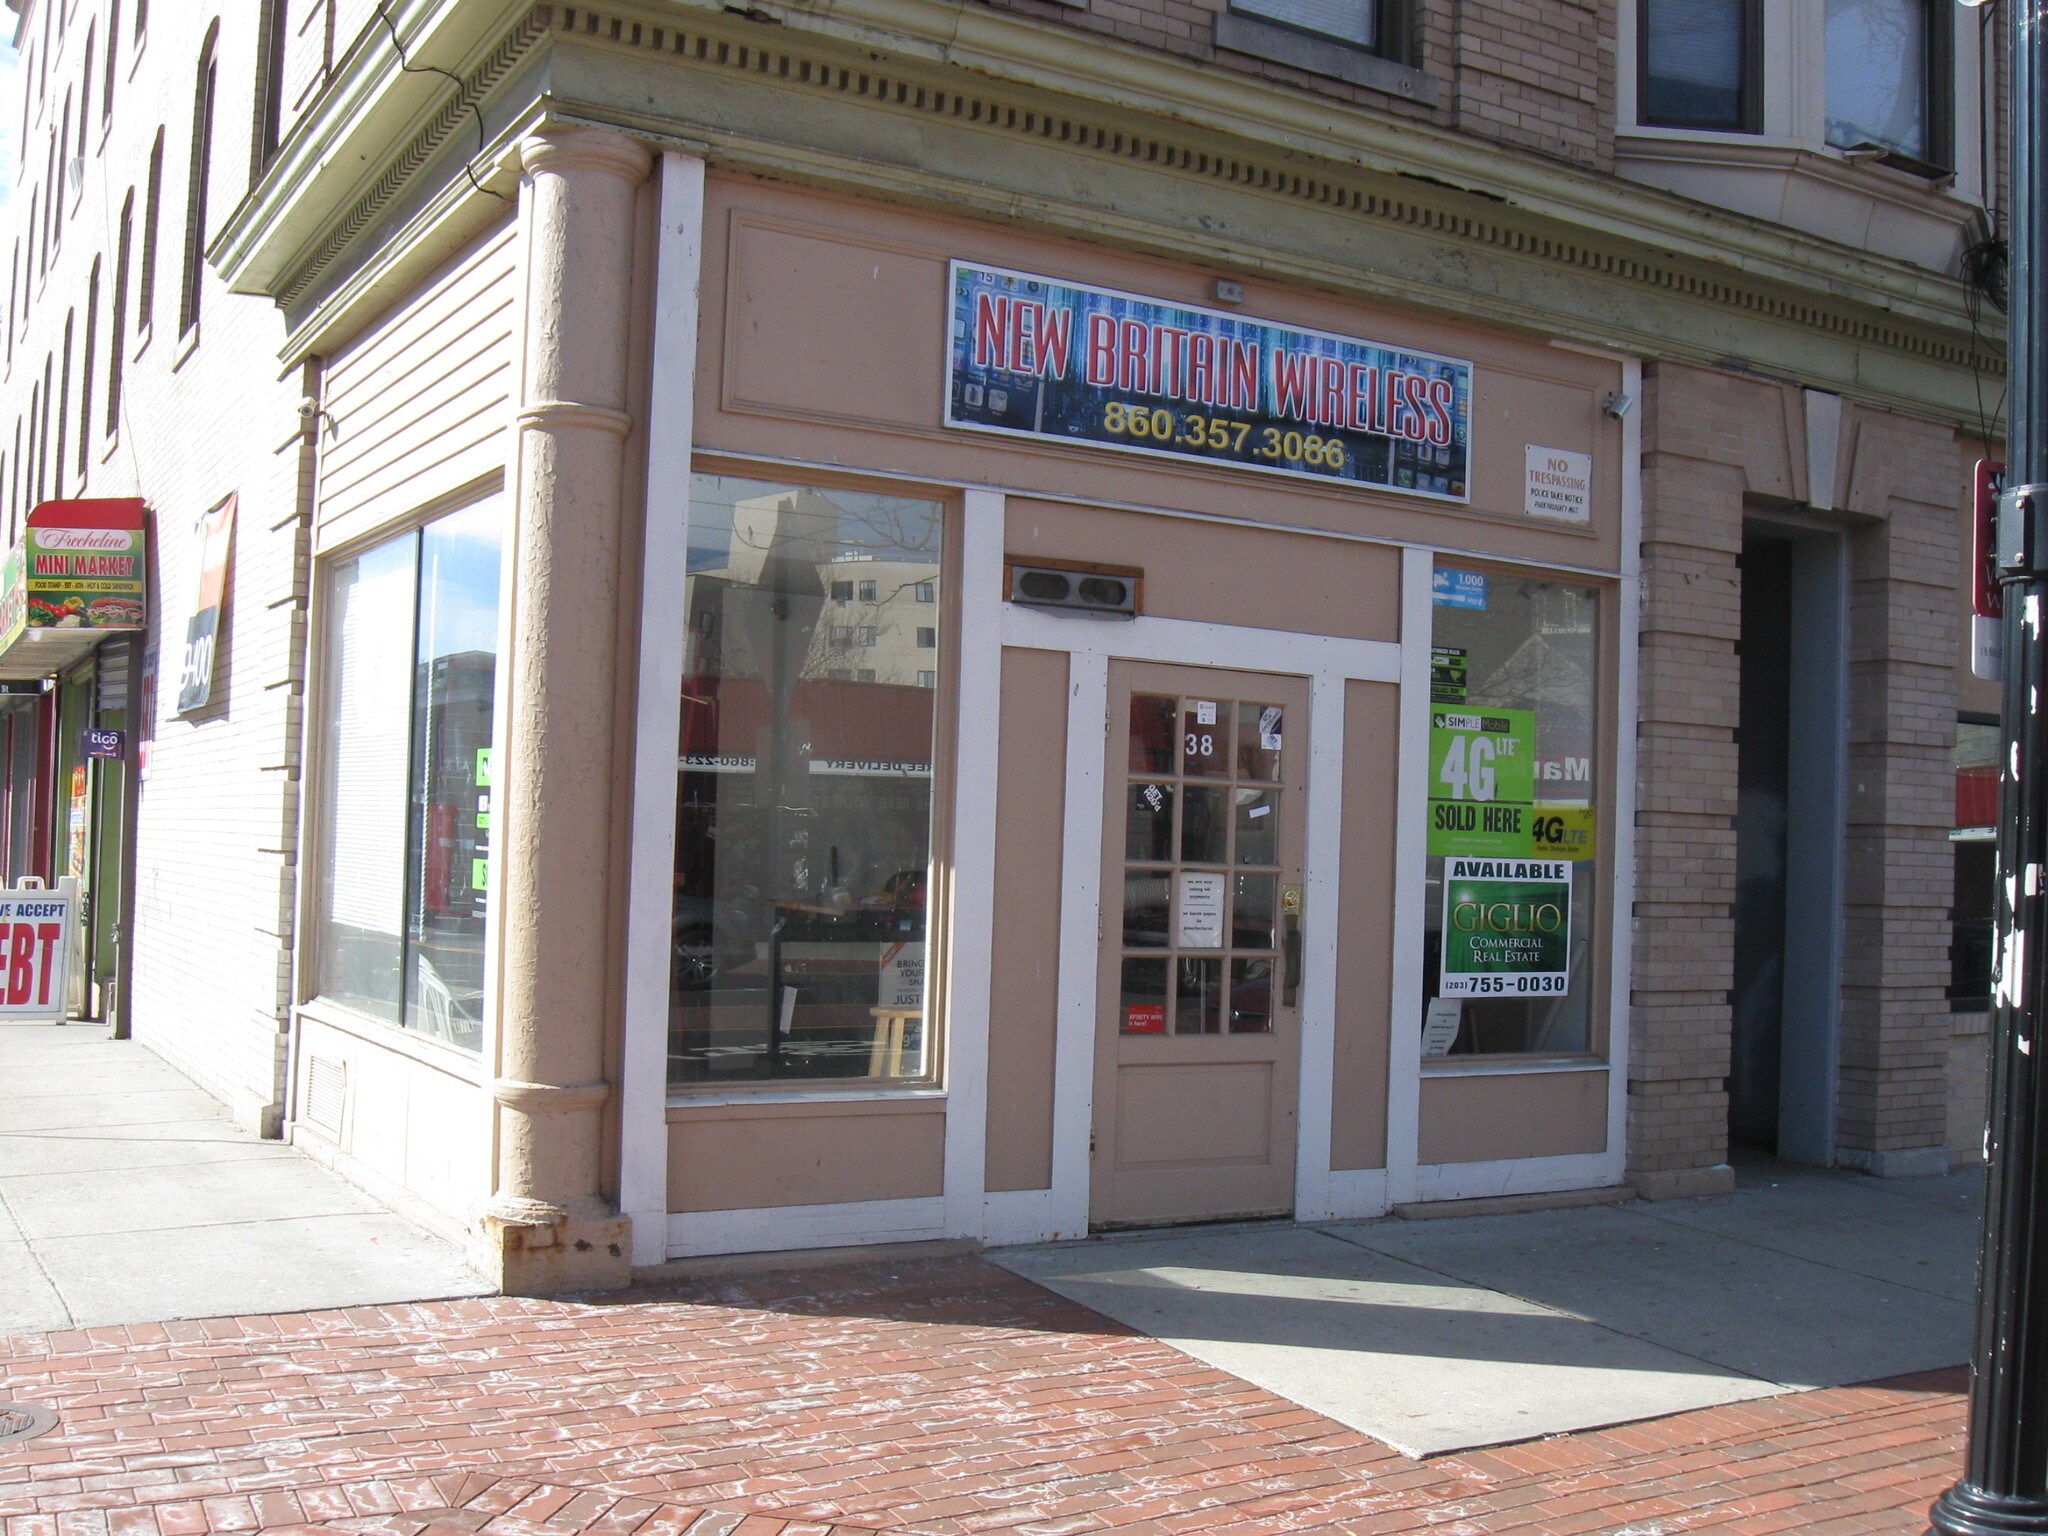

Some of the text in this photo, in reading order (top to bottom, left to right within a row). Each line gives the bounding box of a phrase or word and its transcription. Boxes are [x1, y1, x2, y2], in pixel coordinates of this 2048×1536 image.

[976, 292, 1453, 447] NEW BRITAIN WIRELESS
[1103, 401, 1346, 469] 860.357.3086
[1547, 457, 1569, 473] NO
[1529, 470, 1586, 491] TRESPASSING
[1530, 487, 1584, 504] POLICE TAKE NOTICE
[35, 554, 135, 576] MINI MARKET
[1448, 716, 1480, 729] SIMPLE
[1185, 733, 1213, 756] 38
[1440, 735, 1515, 801] 4G LTE
[1435, 803, 1521, 834] SOLD HERE
[1532, 816, 1564, 843] 4G
[1453, 861, 1564, 879] AVAILABLE
[16, 903, 66, 917] ACCEPT
[1453, 902, 1562, 932] GIGLIO
[1469, 936, 1543, 950] COMMERCIAL
[1473, 950, 1540, 963] REAL ESTATE
[1445, 976, 1565, 993] (203) 755-0030
[893, 994, 921, 1005] JUST
